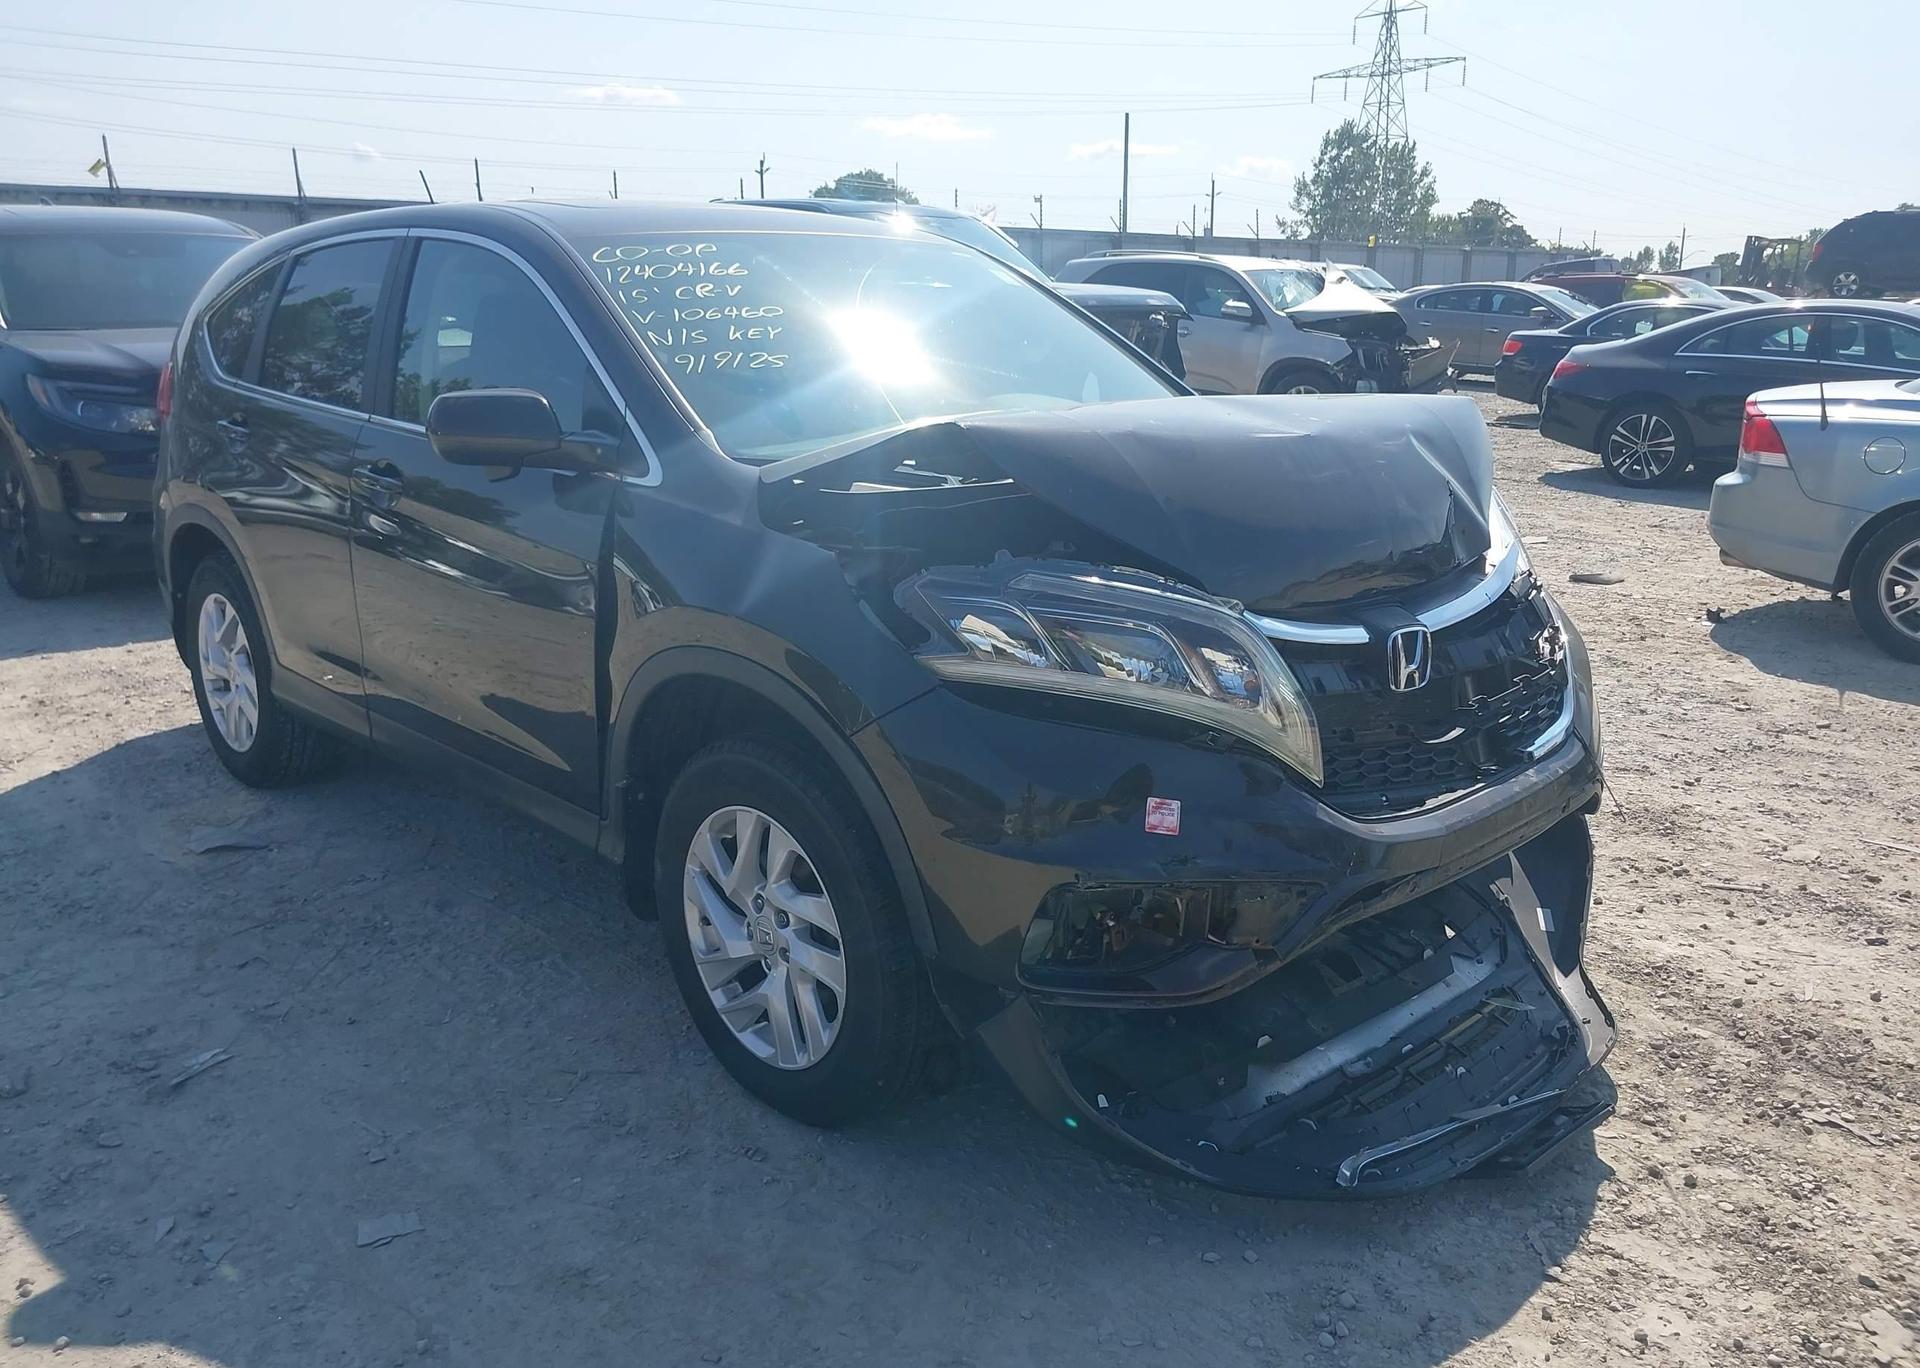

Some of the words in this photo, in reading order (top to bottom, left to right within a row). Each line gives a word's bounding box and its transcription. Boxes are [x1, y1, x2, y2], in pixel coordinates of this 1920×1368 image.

[592, 243, 717, 263] CO-OP
[606, 262, 749, 284] 12404166
[675, 282, 742, 300] CR-V
[632, 306, 784, 324] V-106460
[729, 325, 782, 341] KEY
